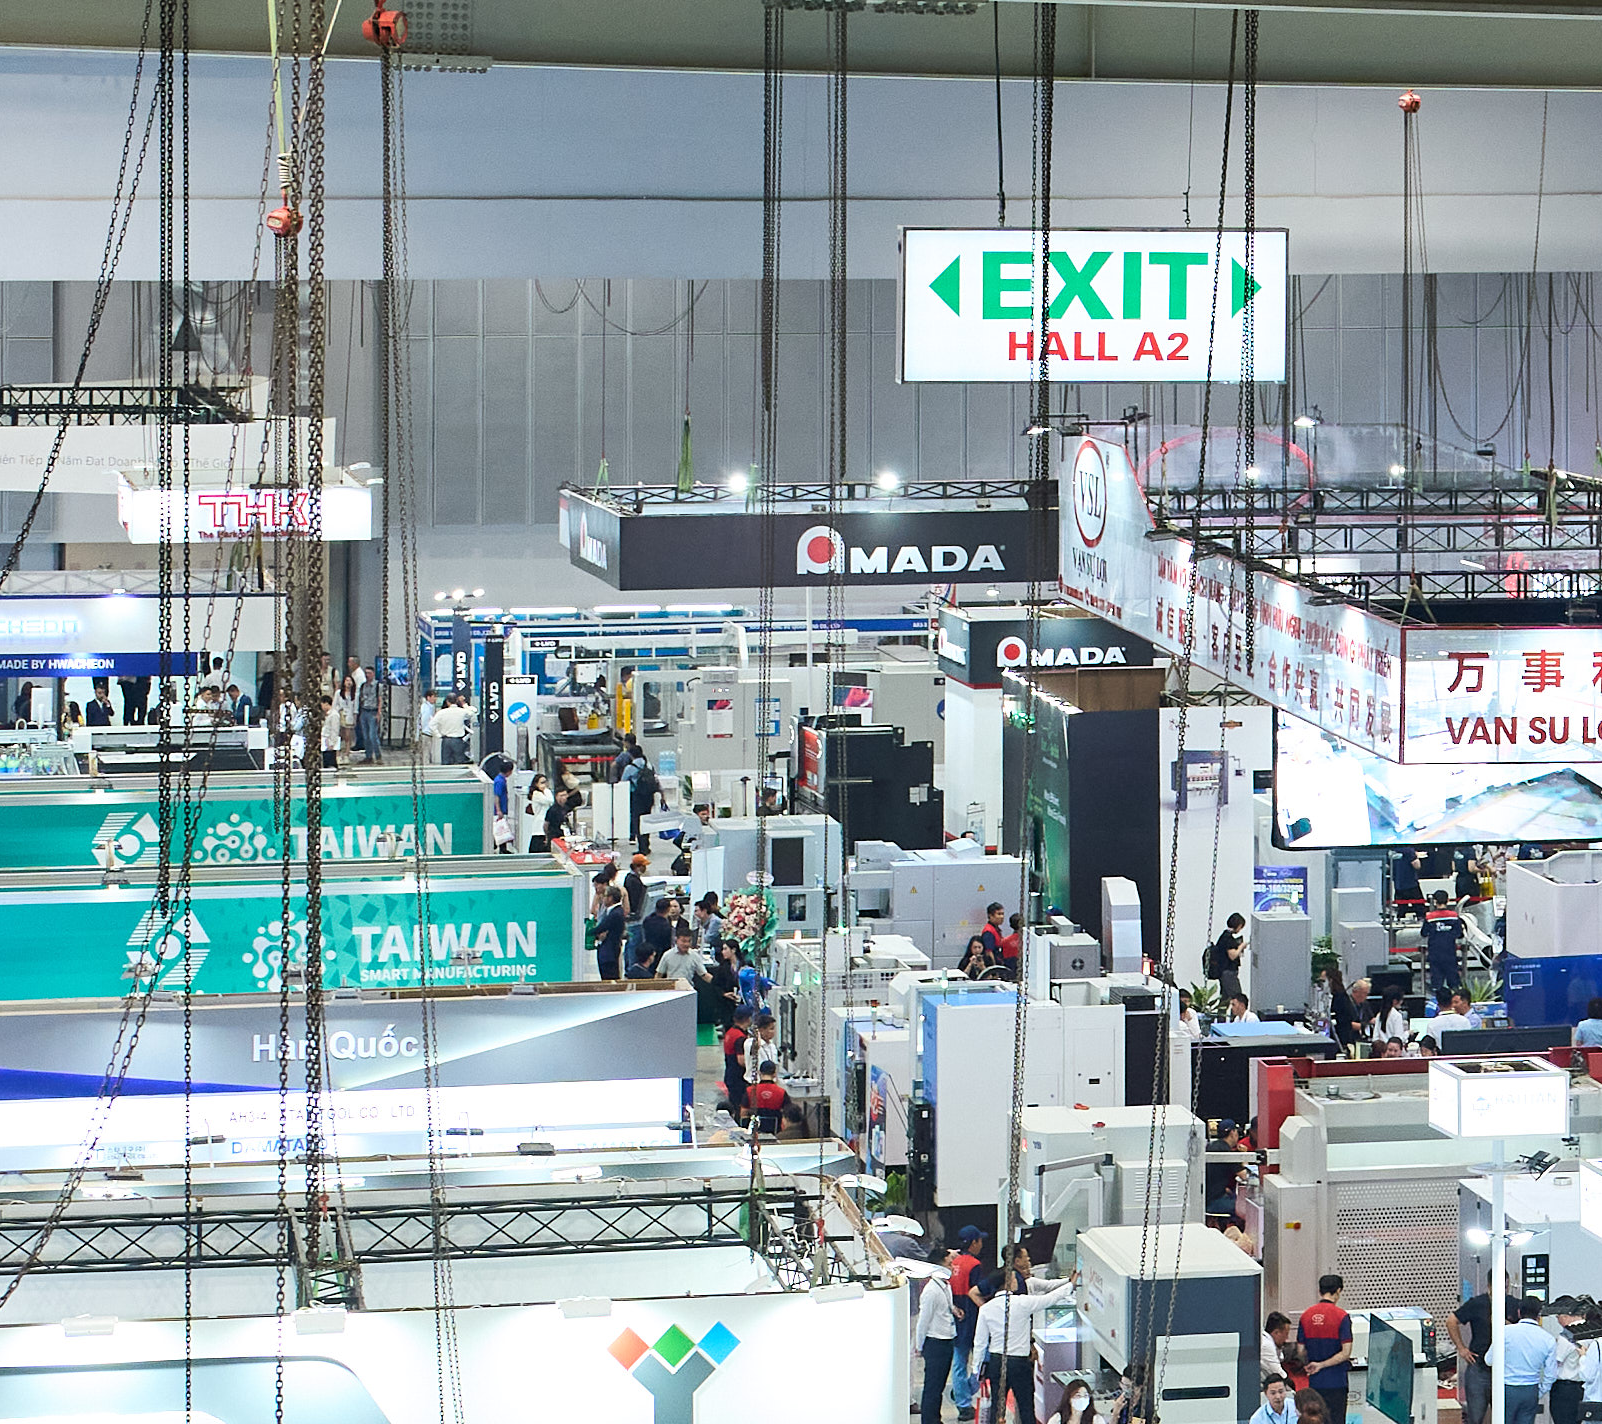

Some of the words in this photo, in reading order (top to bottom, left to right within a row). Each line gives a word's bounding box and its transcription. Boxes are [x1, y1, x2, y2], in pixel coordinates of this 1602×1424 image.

[983, 251, 1208, 320] EXIT
[1008, 332, 1119, 361] HALL
[1133, 332, 1190, 361] A2
[198, 492, 309, 527] THK
[1079, 470, 1101, 518] VSL
[31, 659, 46, 671] BY
[48, 658, 115, 671] HWACHEON
[1445, 715, 1517, 745] VAN
[1528, 715, 1570, 744] SU
[290, 822, 453, 859] TAIWAN
[351, 920, 538, 964] TAIWAN
[360, 967, 410, 982] SMART
[412, 963, 538, 981] MANUFACTURING
[328, 1022, 419, 1061] Quốc
